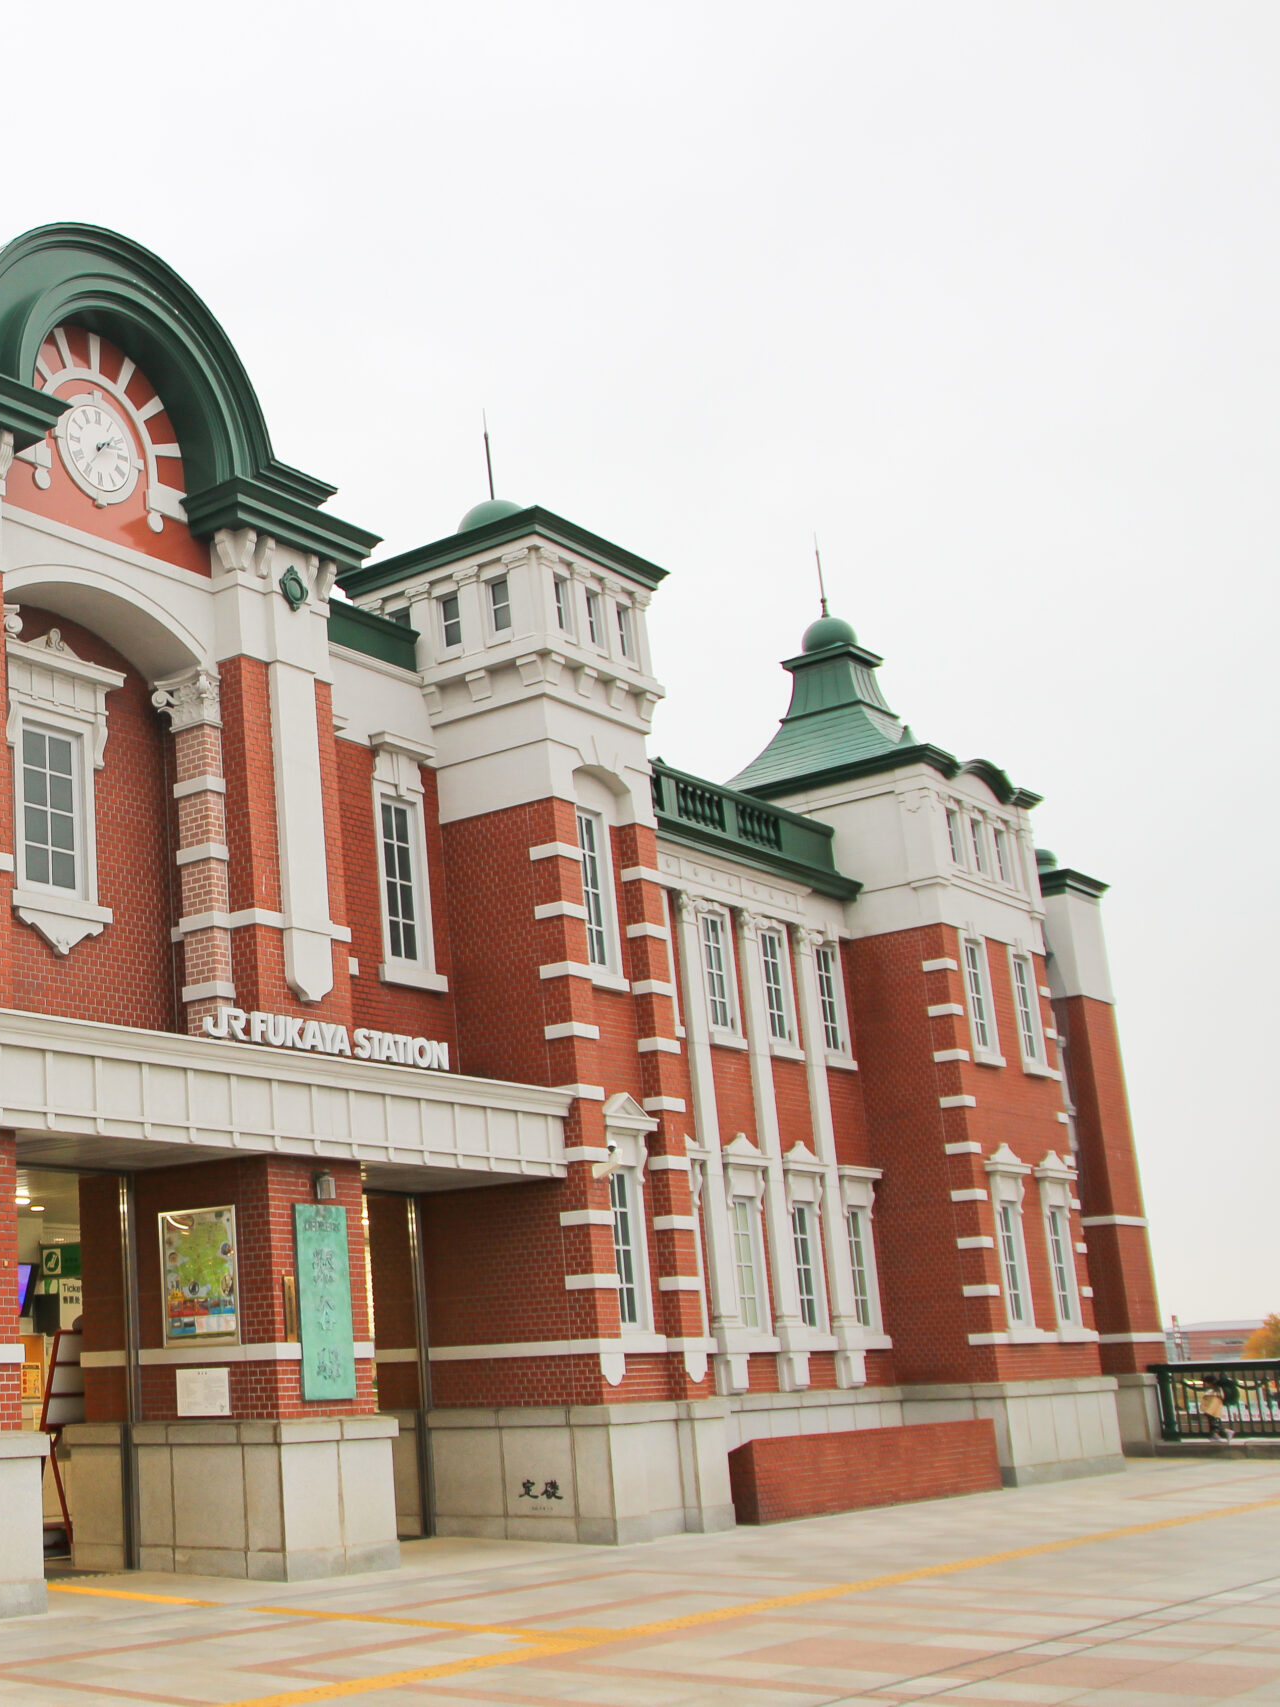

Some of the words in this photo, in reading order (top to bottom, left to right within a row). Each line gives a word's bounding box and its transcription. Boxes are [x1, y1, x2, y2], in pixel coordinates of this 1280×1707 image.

[202, 1006, 250, 1041] JR
[250, 1011, 352, 1057] FUKAYA
[353, 1027, 449, 1071] STATION
